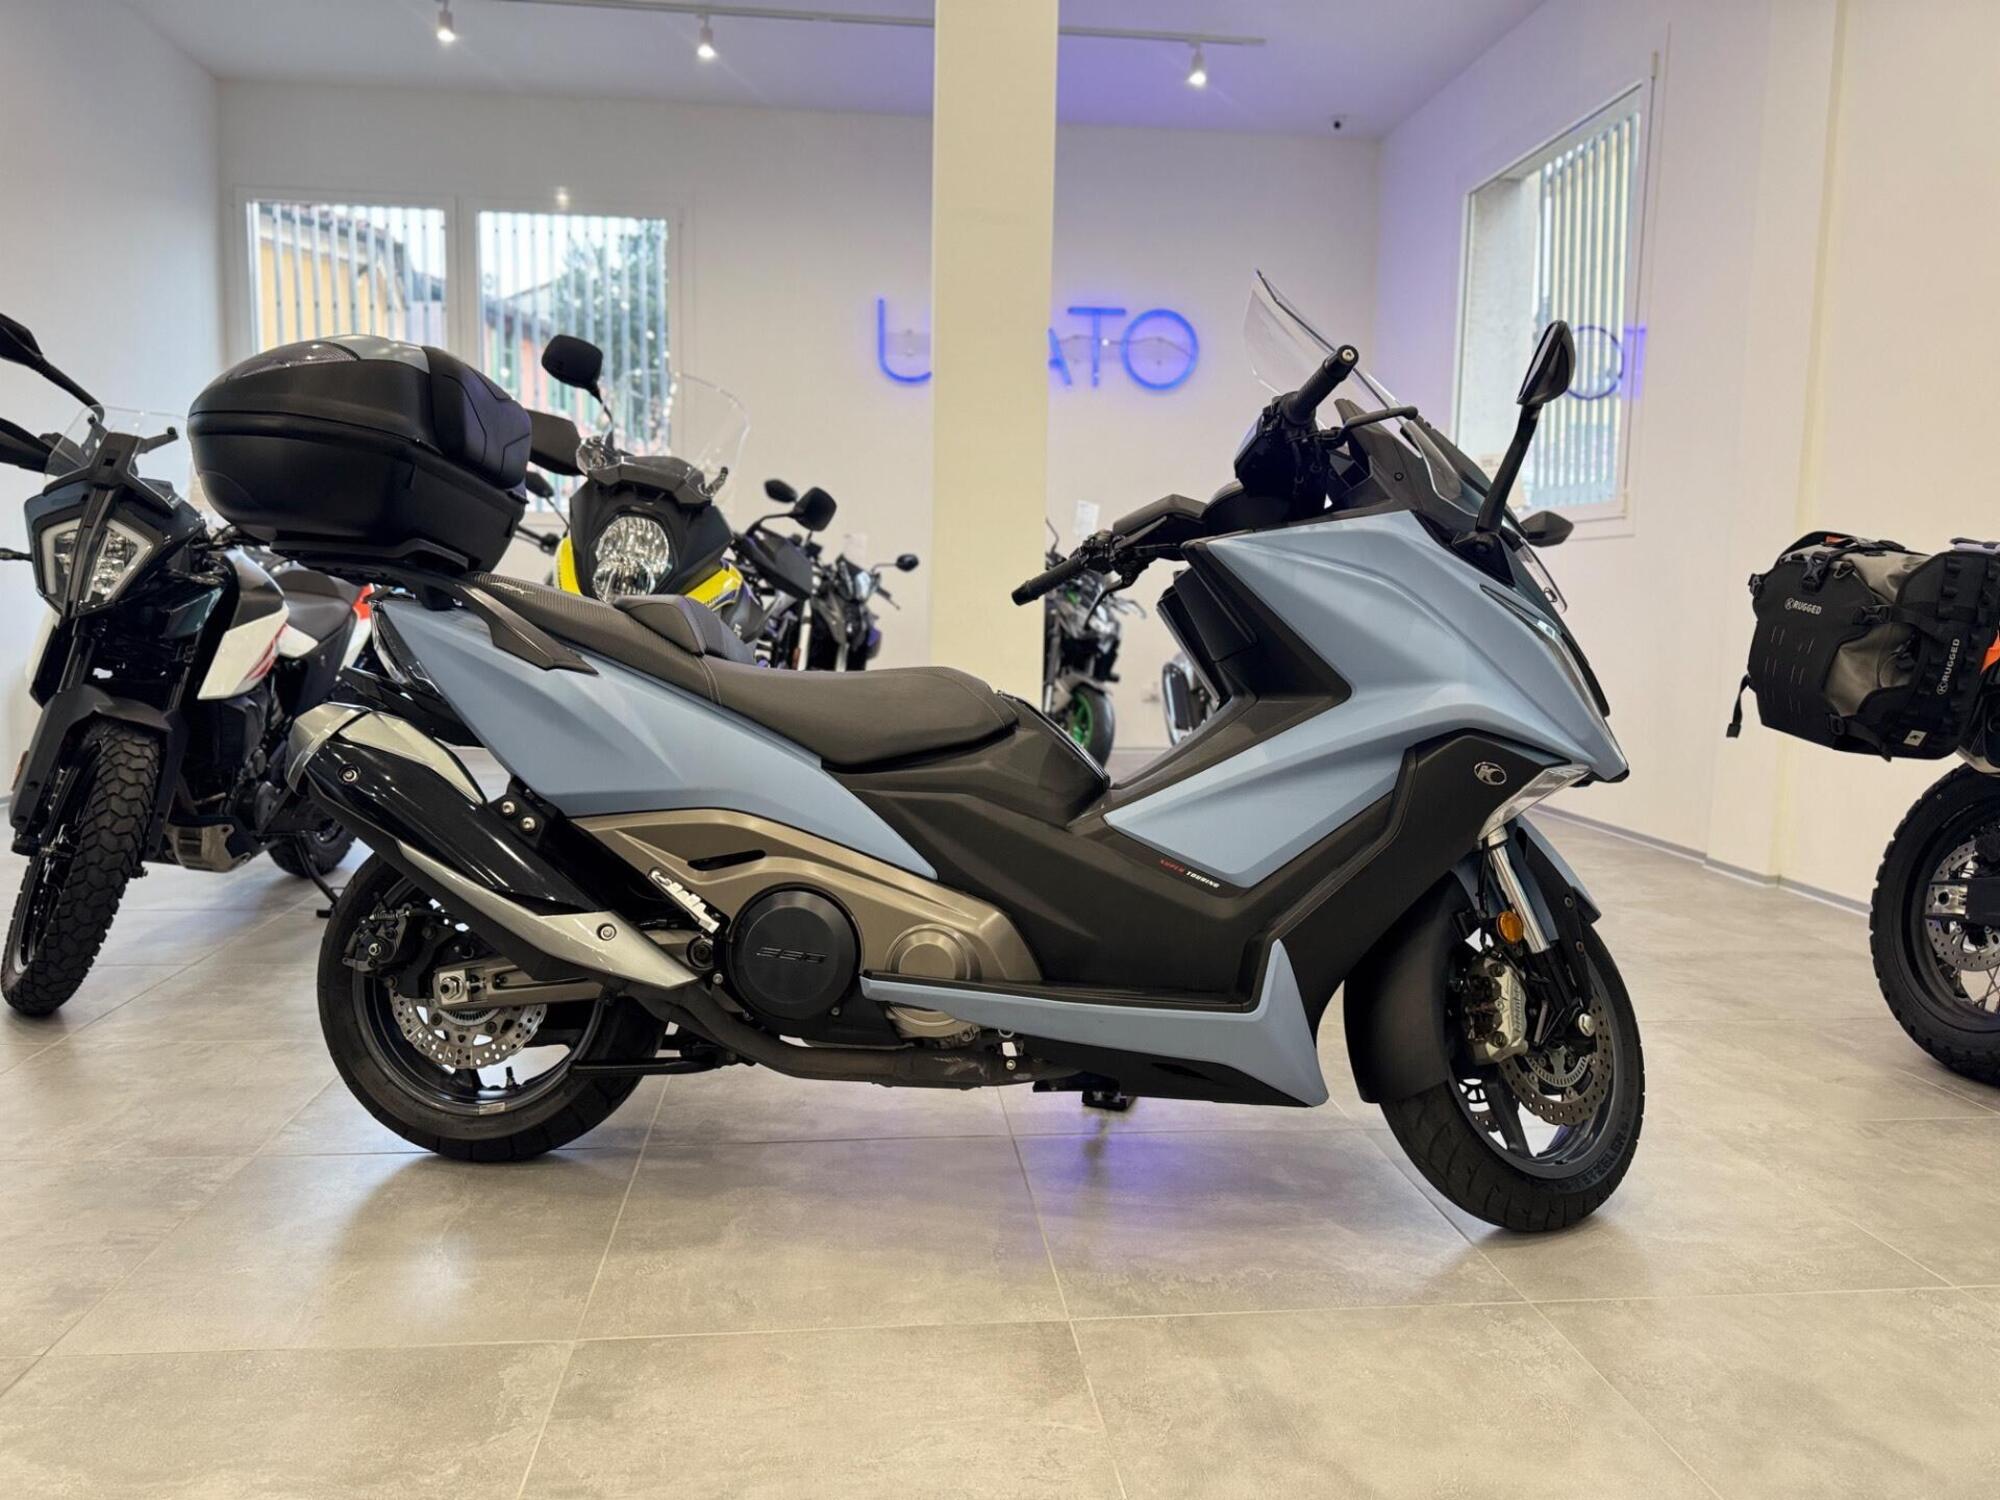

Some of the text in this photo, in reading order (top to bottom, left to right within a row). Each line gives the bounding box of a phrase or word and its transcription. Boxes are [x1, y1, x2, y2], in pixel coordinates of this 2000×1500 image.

[877, 298, 1199, 391] UTO
[1792, 600, 1822, 615] RUGGED
[1942, 638, 1960, 682] RUGGED
